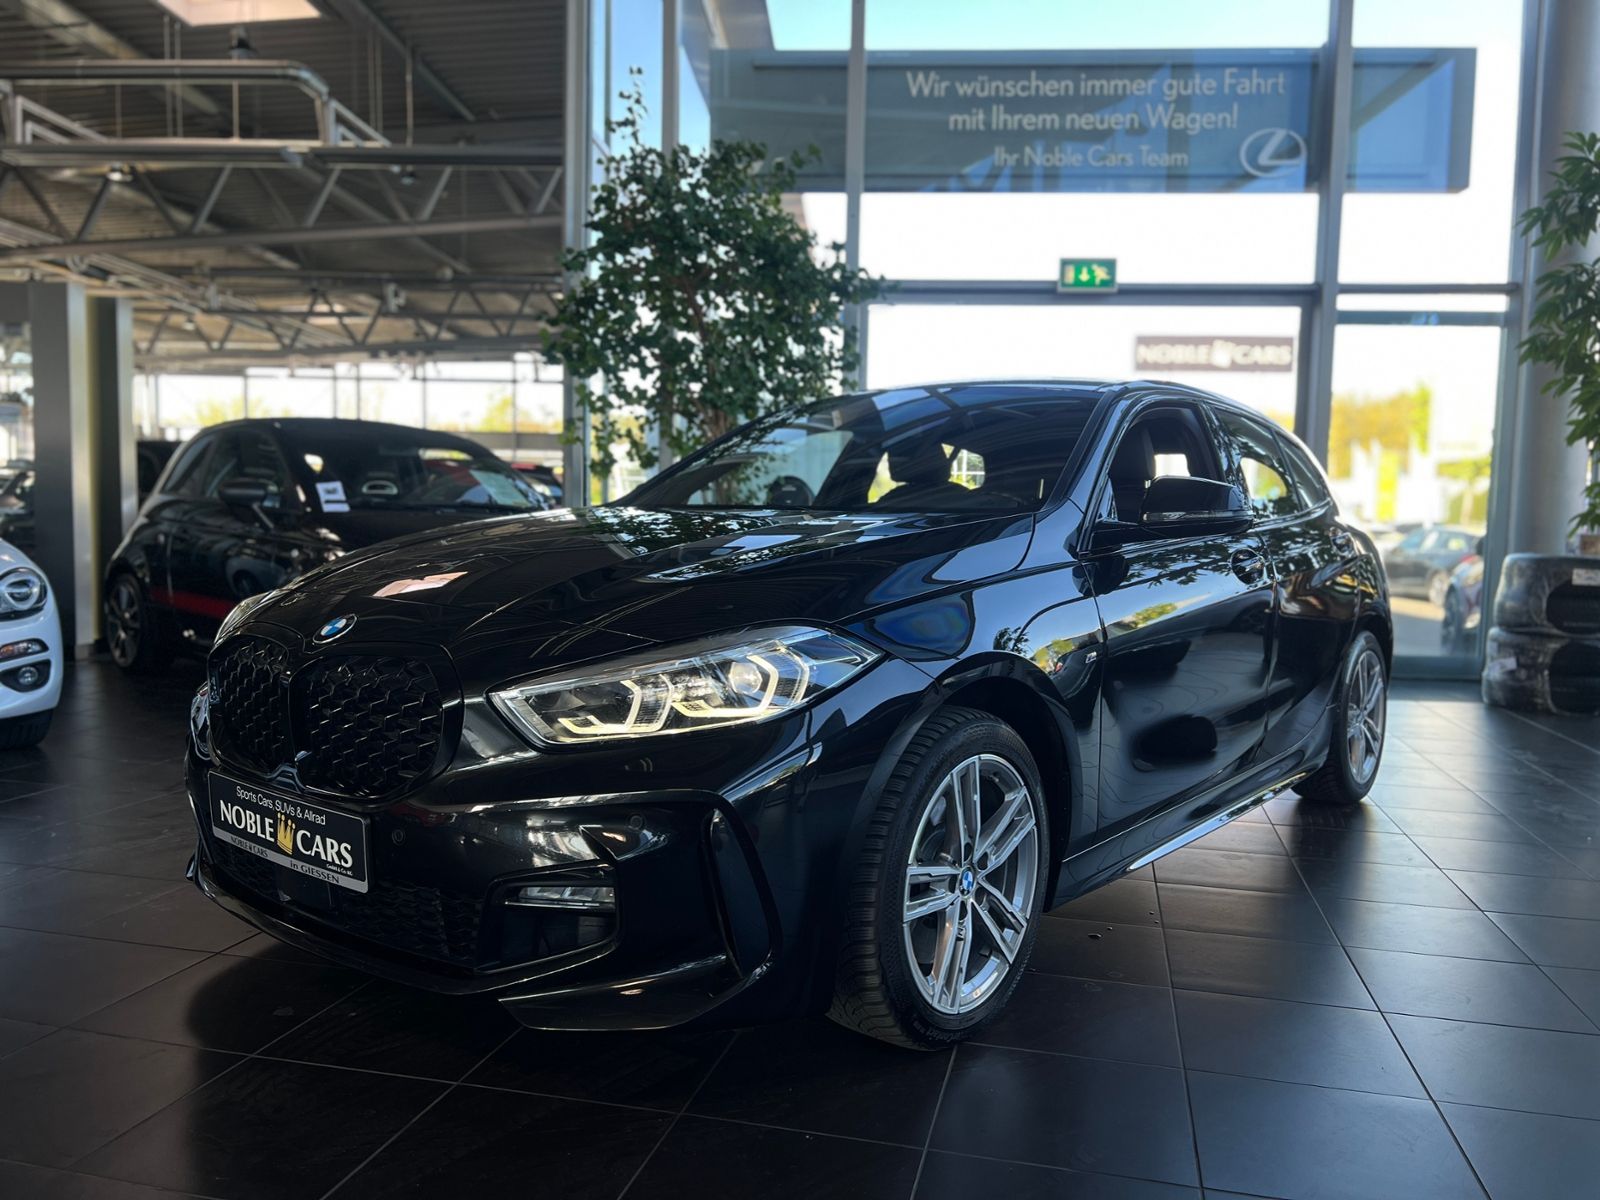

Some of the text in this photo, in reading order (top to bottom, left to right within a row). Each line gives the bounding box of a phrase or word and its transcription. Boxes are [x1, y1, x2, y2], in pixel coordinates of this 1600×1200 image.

[906, 68, 1286, 101] Wir wünschen immer gute Fahrt
[948, 102, 1239, 135] mit Ihrem neuen Wagen!
[994, 144, 1189, 167] Ihr Noble Cars Team
[236, 785, 257, 803] Sports
[275, 799, 295, 817] SUVs
[296, 807, 303, 818] &
[303, 809, 326, 826] Allrad
[219, 799, 354, 868] NOBLE CARS
[290, 859, 340, 884] in GIESSEN
